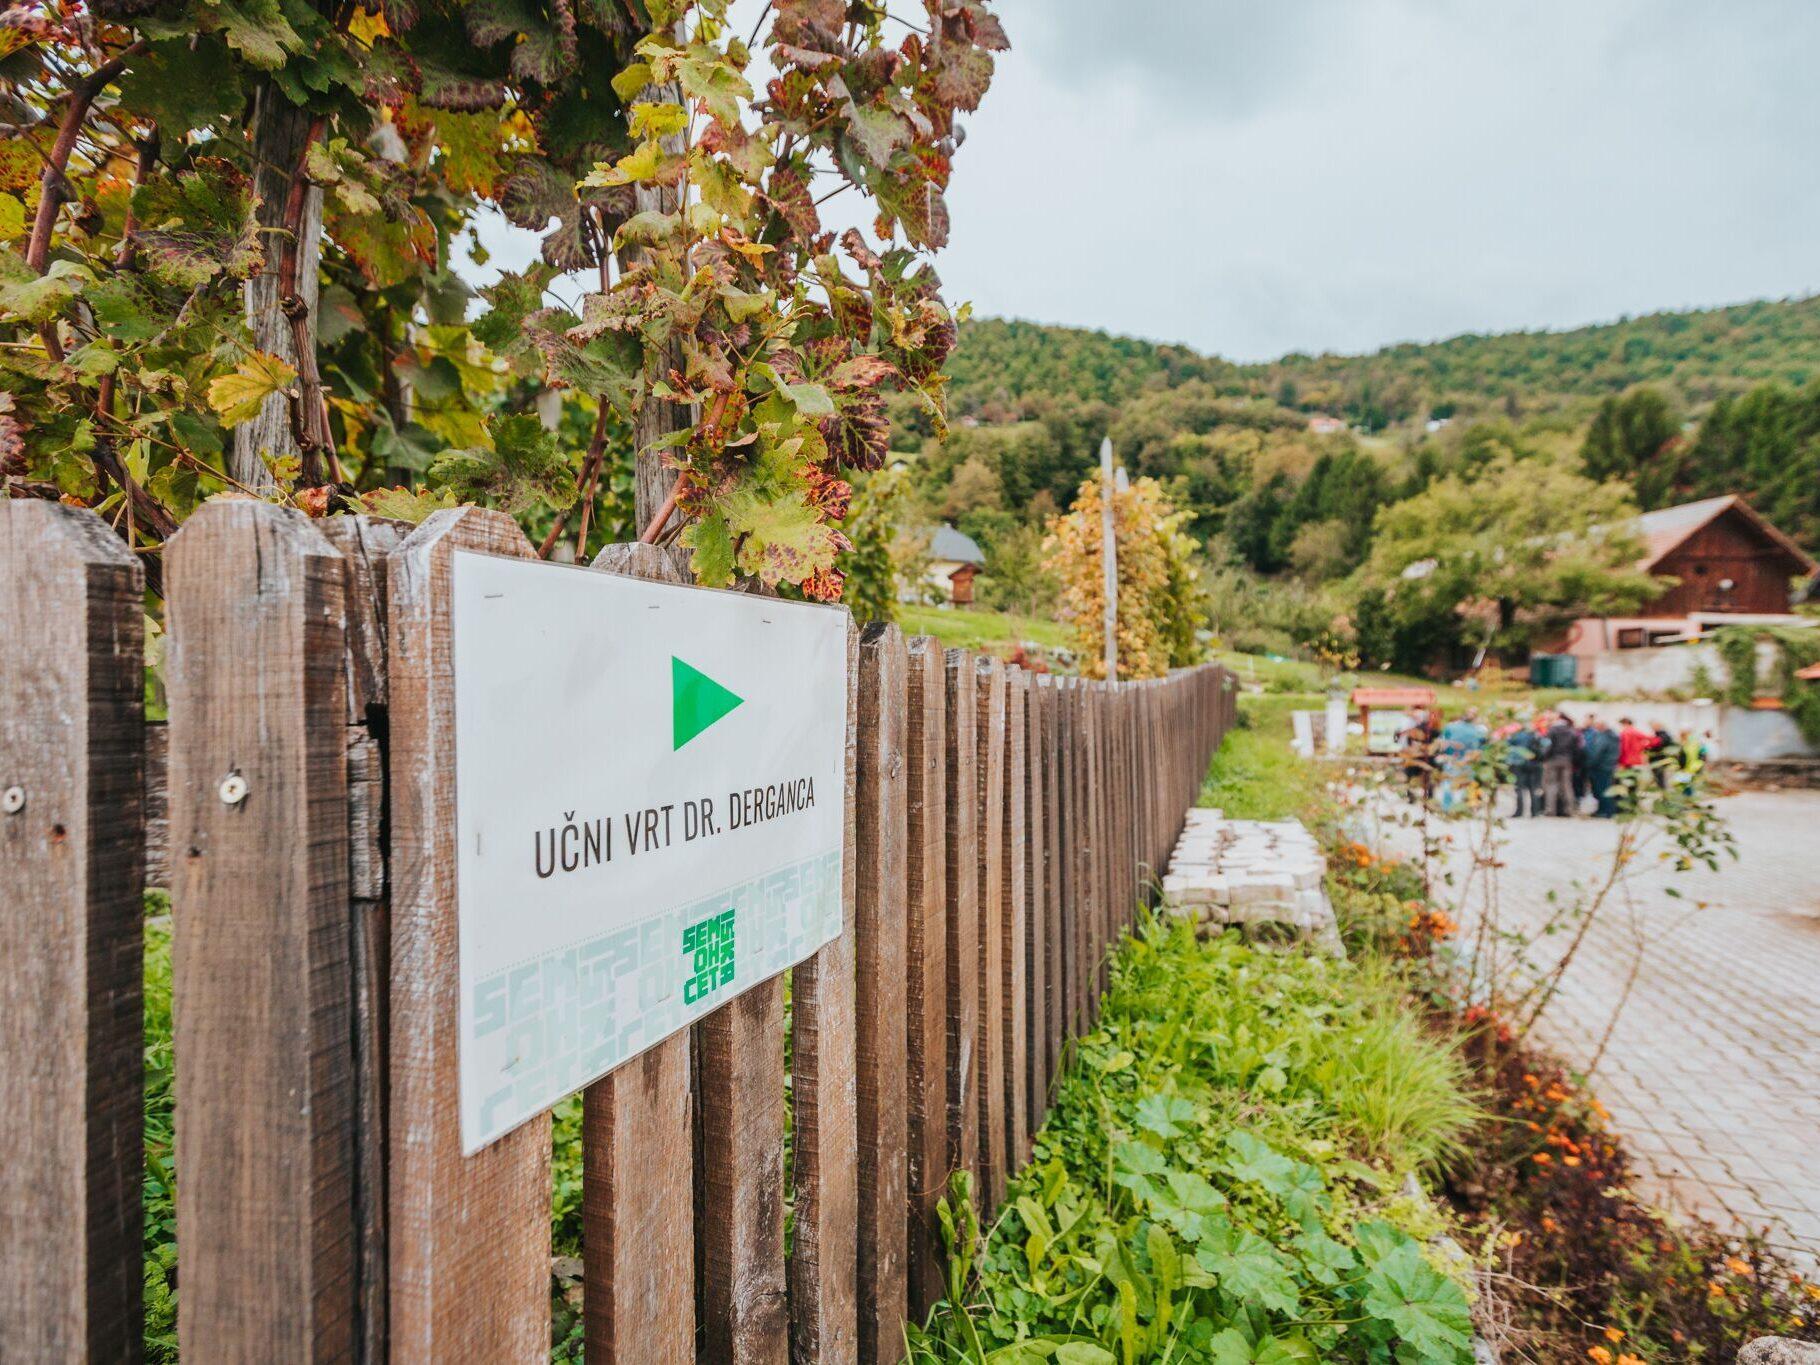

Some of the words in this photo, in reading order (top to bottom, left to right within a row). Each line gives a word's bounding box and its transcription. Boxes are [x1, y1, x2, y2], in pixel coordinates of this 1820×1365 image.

[535, 811, 612, 879] UČNI
[624, 804, 675, 857] VRT
[684, 798, 722, 842] DR.
[729, 776, 816, 831] DERGANCA
